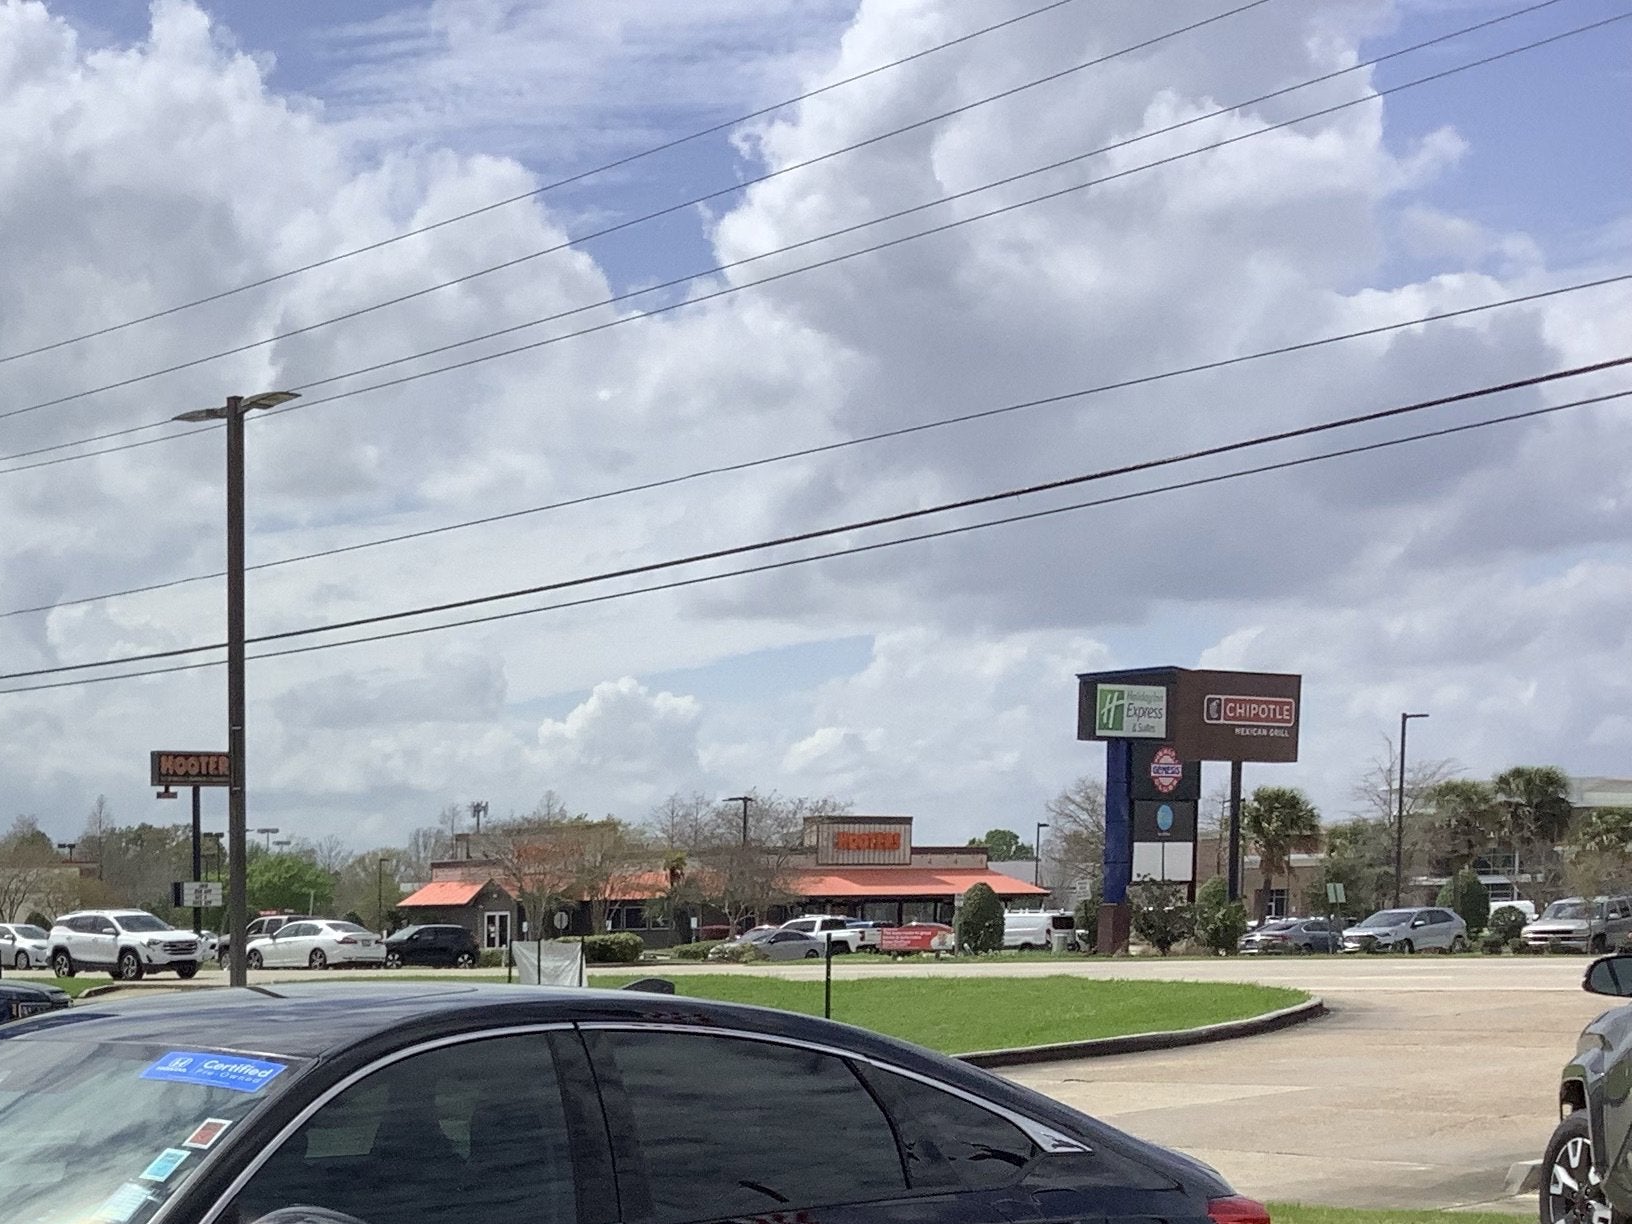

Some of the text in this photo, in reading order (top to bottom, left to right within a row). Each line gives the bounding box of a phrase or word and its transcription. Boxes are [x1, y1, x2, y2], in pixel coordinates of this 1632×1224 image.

[1126, 703, 1163, 721] Express
[1226, 703, 1290, 719] CHIPOTLE
[1234, 727, 1290, 737] MEXICAN GRILL
[160, 755, 230, 775] HOOTER
[202, 1059, 274, 1079] Certified
